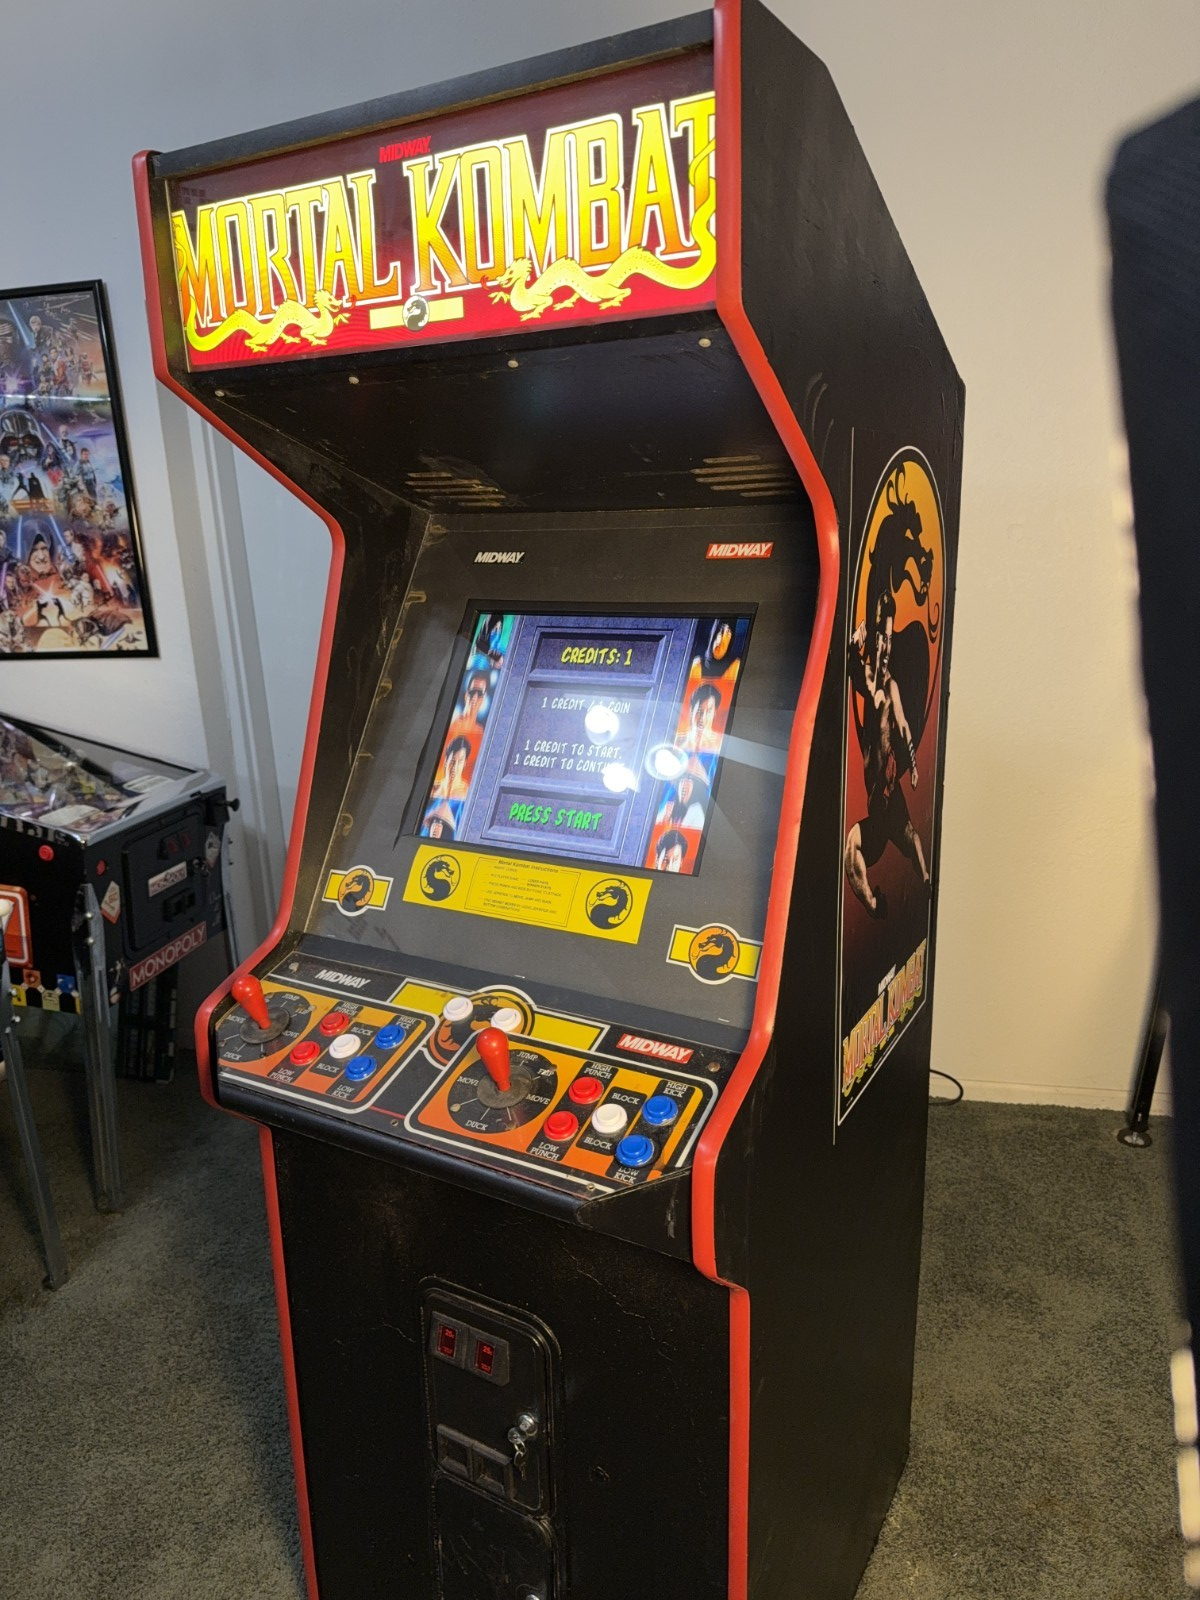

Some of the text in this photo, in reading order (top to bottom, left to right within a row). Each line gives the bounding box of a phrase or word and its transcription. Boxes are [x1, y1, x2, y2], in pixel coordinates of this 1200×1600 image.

[379, 135, 431, 163] MIDWAY
[172, 91, 716, 329] MORTAL KOMBAT
[707, 542, 772, 558] MIDWAY
[474, 551, 525, 564] MIDWAY
[561, 646, 633, 666] CREDITS: 1
[541, 696, 548, 709] 1
[551, 697, 586, 711] CREDIT
[608, 700, 632, 714] COIN
[524, 740, 623, 760] 1 CREDIT TO START.
[514, 754, 520, 766] 1
[523, 754, 558, 769] CREDIT
[560, 757, 574, 771] TO
[508, 802, 603, 831] PRESS START
[131, 924, 206, 988] MONOPOLY
[315, 968, 371, 990] MIDWAY
[351, 1026, 373, 1036] BLOCK
[620, 1035, 692, 1061] MIDWAY
[842, 990, 888, 1094] MORTAL
[223, 1051, 242, 1061] DUCK
[517, 1051, 539, 1062] JUMP
[278, 1067, 295, 1077] LOW
[316, 1062, 340, 1074] BLOCK
[584, 1067, 613, 1080] PUNCH
[591, 1062, 612, 1073] HIGH
[269, 1072, 294, 1084] PUNCH
[337, 1084, 355, 1094] LOW
[662, 1088, 685, 1099] KICK
[665, 1081, 688, 1093] HIGH
[331, 1089, 351, 1101] KICK
[526, 1093, 551, 1105] MOVE
[611, 1092, 641, 1105] BLOCK
[465, 1119, 489, 1131] DUCK
[538, 1141, 560, 1152] LOW
[583, 1136, 613, 1151] BLOCK
[529, 1146, 560, 1161] PUNCH
[613, 1171, 637, 1185] KICK
